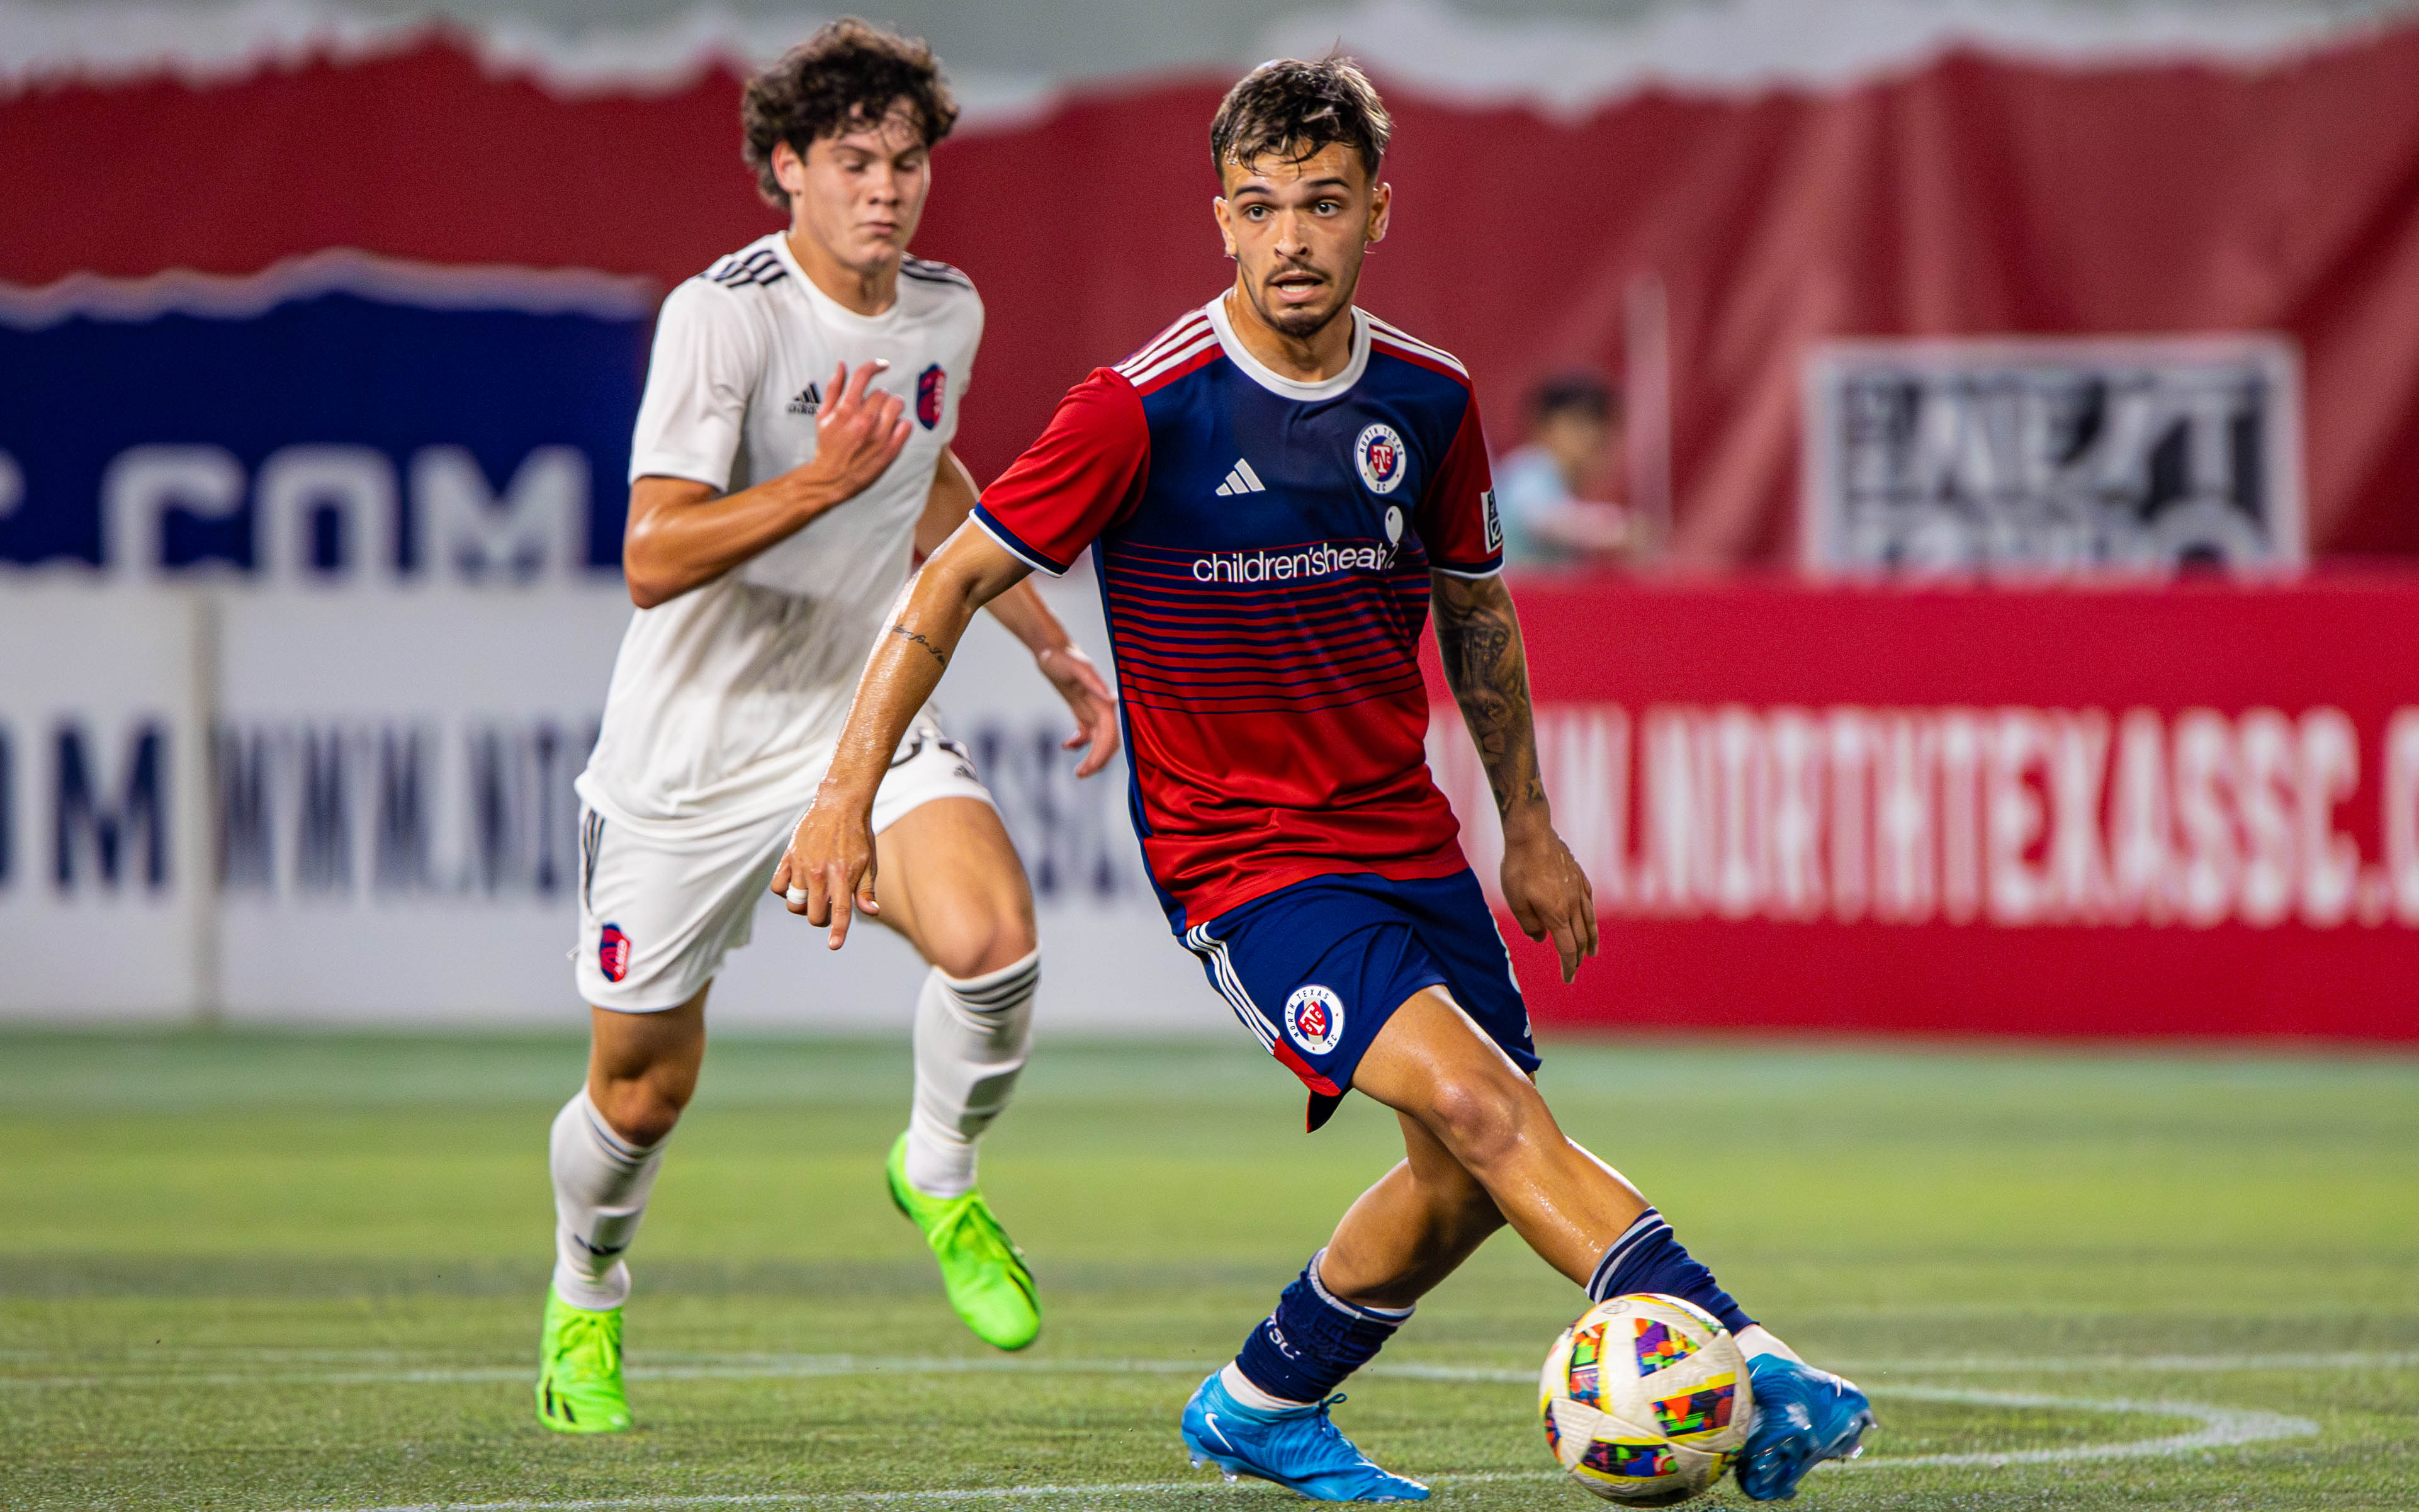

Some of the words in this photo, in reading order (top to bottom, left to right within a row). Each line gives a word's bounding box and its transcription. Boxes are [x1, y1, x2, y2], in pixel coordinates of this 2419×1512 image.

[1384, 427, 1403, 455] TEXAS
[1287, 1003, 1299, 1038] NORTH
[1296, 989, 1329, 1000] TEXAS
[1327, 1034, 1337, 1047] SC
